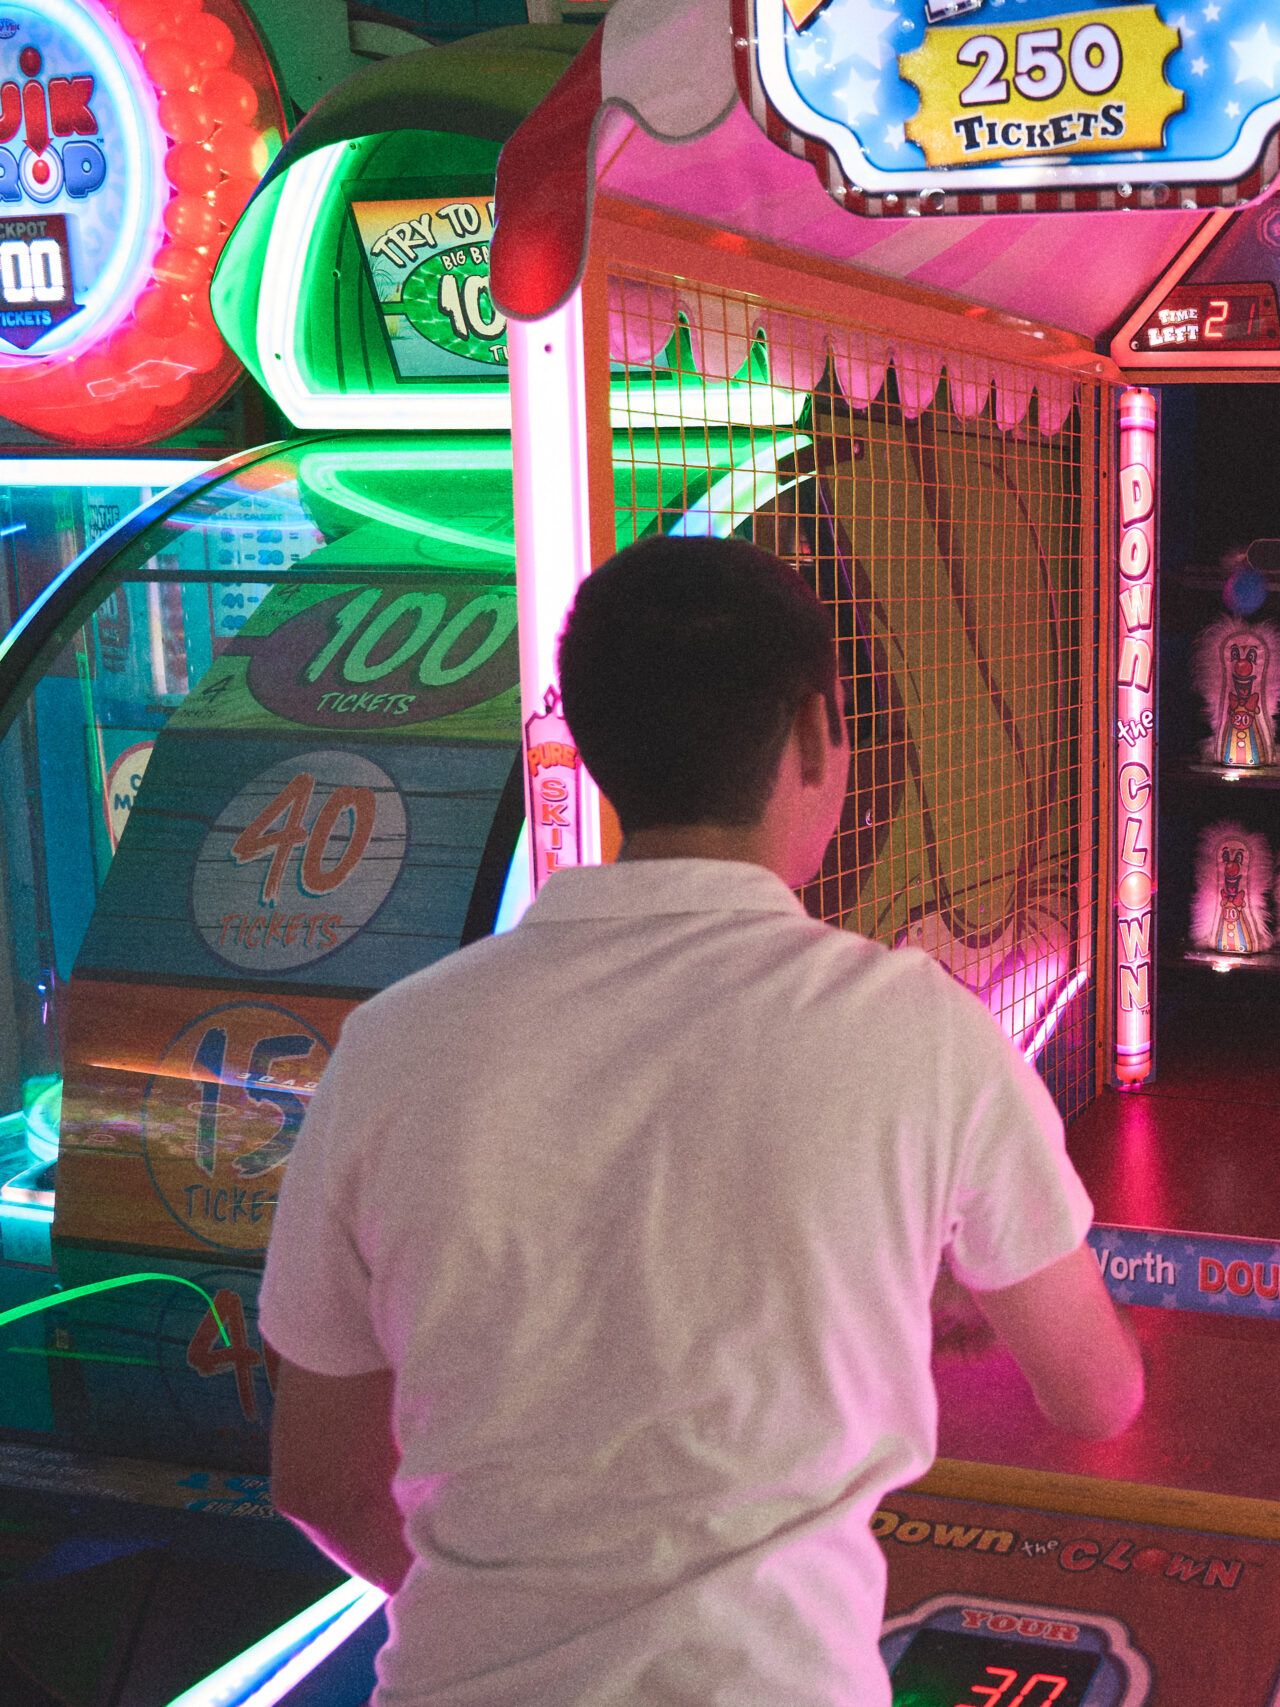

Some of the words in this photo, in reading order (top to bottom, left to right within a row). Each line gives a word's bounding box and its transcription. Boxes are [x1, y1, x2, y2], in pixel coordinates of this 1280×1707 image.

[957, 23, 1123, 107] 250
[954, 104, 1125, 150] TICKETS
[371, 213, 438, 268] TRY
[436, 203, 481, 238] TO
[441, 250, 467, 271] BIG
[1148, 325, 1199, 346] LEFT
[1158, 308, 1198, 325] TIME
[303, 587, 519, 687] 100
[316, 692, 416, 715] TICKETS
[1233, 714, 1251, 726] 20
[1117, 709, 1154, 748] the
[527, 741, 577, 778] PURE
[228, 772, 377, 908] 40
[218, 911, 343, 949] TICKETS
[190, 1026, 316, 1180] 15
[187, 1289, 281, 1422] 4
[1020, 1537, 1060, 1558] the
[960, 1608, 1080, 1643] YOUR
[953, 1665, 1068, 1707] 30
